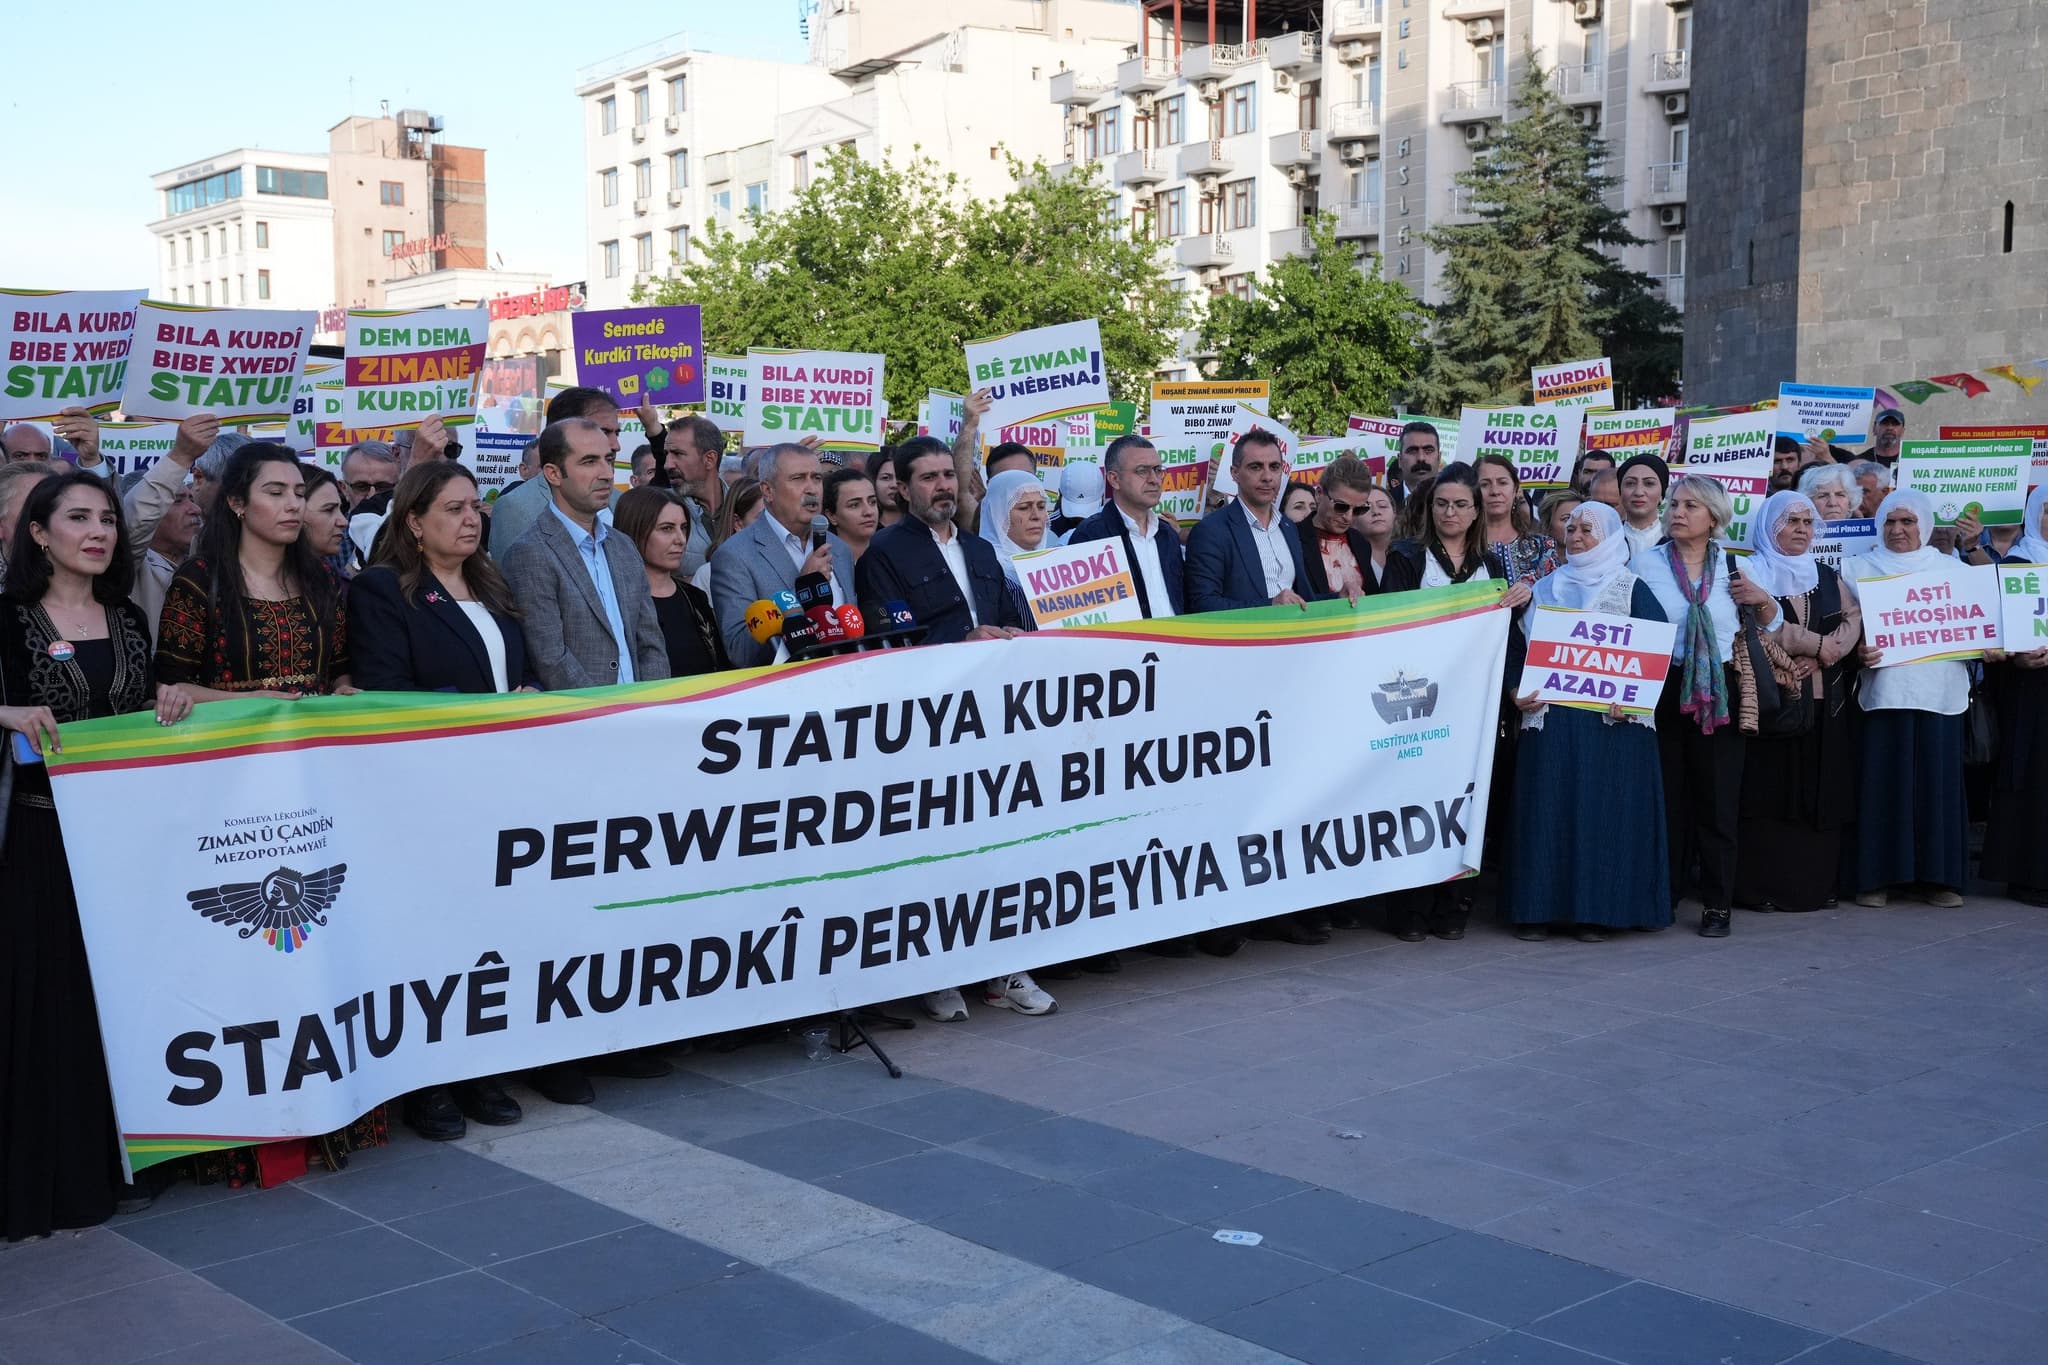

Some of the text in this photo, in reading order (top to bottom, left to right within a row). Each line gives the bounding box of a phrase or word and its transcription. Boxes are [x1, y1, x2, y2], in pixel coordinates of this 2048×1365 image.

[13, 311, 72, 333] BILA
[604, 318, 665, 338] Semedê
[157, 323, 304, 349] BILA KURDÎ
[359, 328, 471, 346] DEM DEMA
[9, 341, 67, 362] BIBE
[152, 349, 298, 375] BIBE XWEDÎ
[584, 342, 693, 366] Kurdkî Têkoşîn
[358, 354, 471, 382] ZIMANÊ
[976, 346, 1087, 381] BÊ ZIWAN
[3, 360, 128, 398] STATU!
[763, 365, 808, 382] BILA
[814, 367, 873, 385] KURDÎ
[1538, 362, 1605, 388] KURDKÎ
[148, 371, 293, 407] STATU!
[357, 385, 443, 411] KURDÎ
[712, 381, 732, 399] BI
[762, 387, 805, 404] BIBE
[809, 389, 872, 406] XWEDÎ
[1539, 382, 1607, 398] NASNAMEYÊ
[761, 405, 872, 433] STATU!
[1171, 404, 1219, 415] WA ZIWANÊ
[1487, 413, 1557, 428] HER CA
[1185, 419, 1205, 427] BIBO
[1594, 418, 1660, 430] DEM DEMA
[102, 439, 125, 450] MA
[1484, 429, 1557, 446] KURDKÎ
[1593, 432, 1660, 448] ZIMANÊ
[1693, 433, 1713, 449] BÊ
[1717, 430, 1766, 448] ZIWAN
[1324, 448, 1369, 462] DEA
[1519, 450, 1559, 463] DEM
[1689, 454, 1710, 464] CU
[1913, 465, 2018, 479] WA ZIWANÊ KURDKÎ
[1940, 482, 1983, 494] ZIWANO
[1985, 479, 2017, 493] FERMÎ
[1027, 545, 1119, 595] KURDKÎ
[1906, 582, 1951, 605] AŞTÎ
[2004, 572, 2040, 594] BÊ
[1035, 581, 1128, 614] NASNAMEYÊ
[1062, 611, 1109, 628] MA YA!
[1879, 603, 1984, 627] TÊKOŞÎNA
[1570, 620, 1634, 646] AŞTÎ
[1875, 624, 1997, 648] BI HEYBET E
[1548, 645, 1643, 677] JIYANA
[1544, 672, 1639, 702] AZAD E
[697, 652, 1160, 775] STATUYA KURDÎ
[1397, 746, 1424, 760] AMED
[494, 709, 1273, 887] PERWERDEHIYA BI KURDÎ
[197, 830, 257, 852] ZIMAN
[260, 826, 274, 842] Û
[214, 835, 328, 865] MEZOPOTAMYAYÊ
[165, 950, 511, 1106] STATUYÊ
[536, 906, 805, 1024] KURDKÎ
[819, 837, 1228, 974] PERWERDEYÎYA
[1237, 832, 1286, 886] BI
